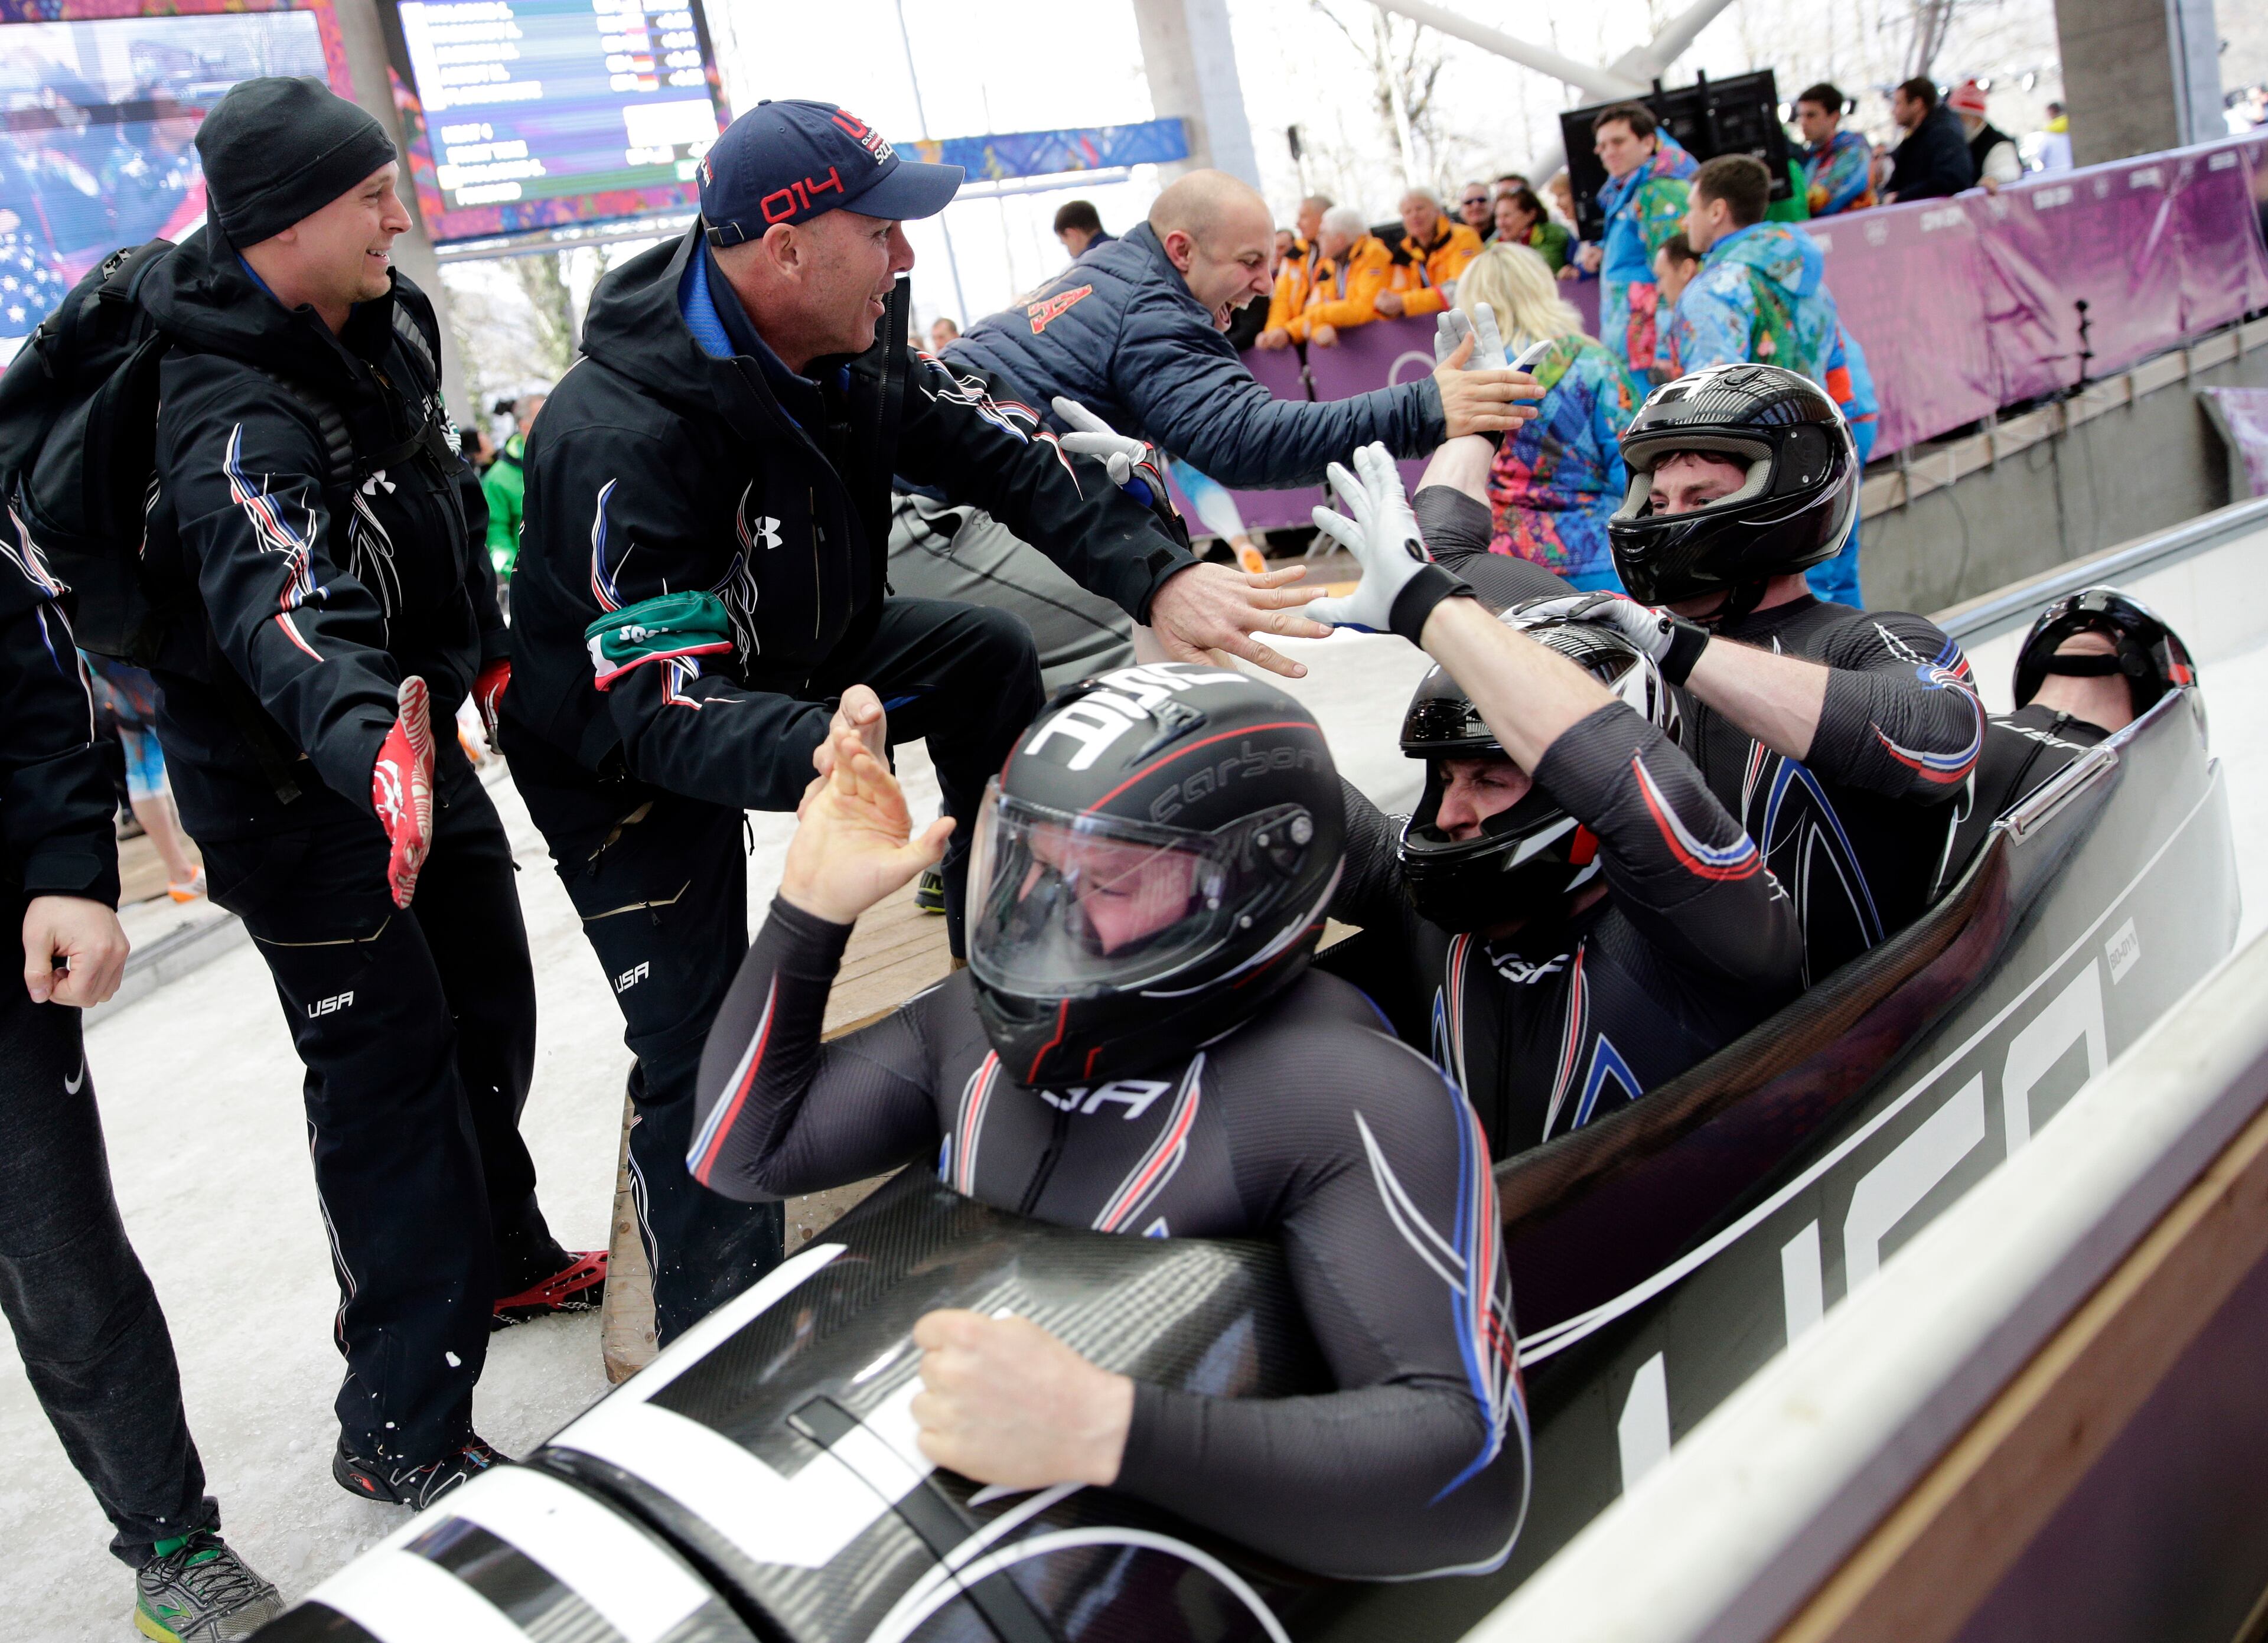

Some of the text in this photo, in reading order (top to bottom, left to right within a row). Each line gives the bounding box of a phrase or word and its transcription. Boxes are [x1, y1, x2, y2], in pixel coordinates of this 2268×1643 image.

[760, 166, 845, 224] 014
[1149, 740, 1324, 823] carbon
[615, 961, 650, 994] USA
[308, 990, 354, 1019] USA
